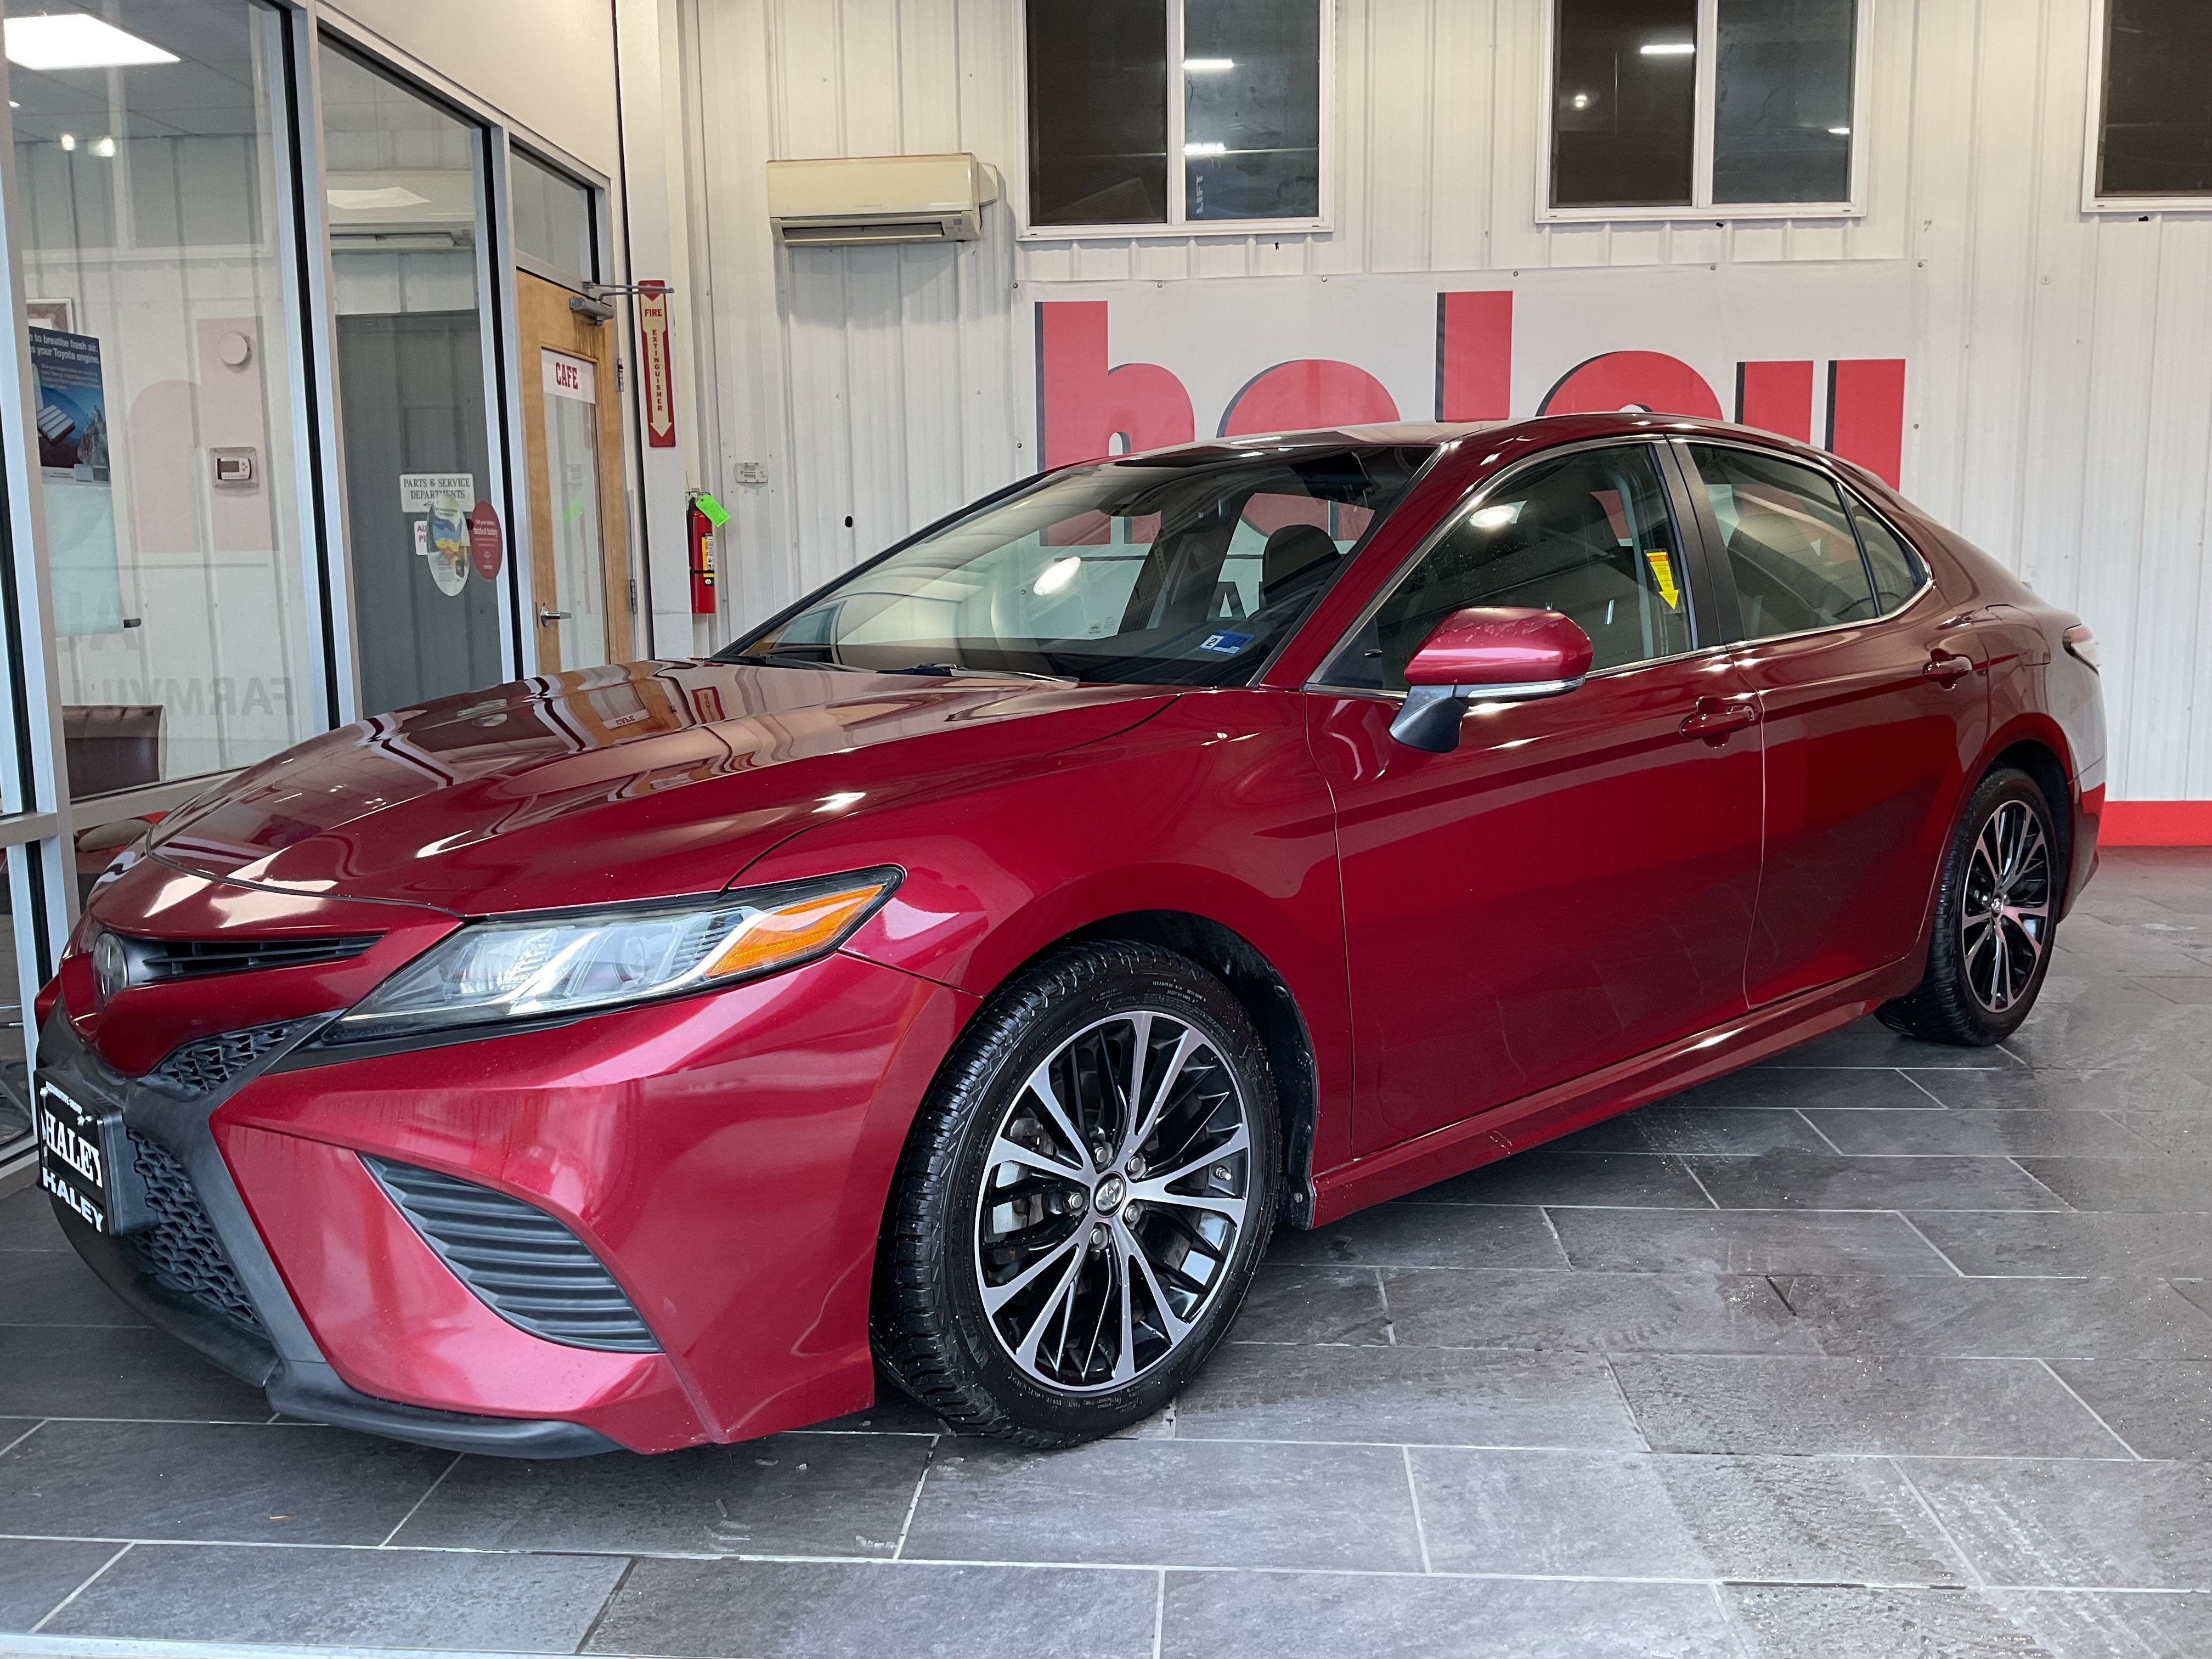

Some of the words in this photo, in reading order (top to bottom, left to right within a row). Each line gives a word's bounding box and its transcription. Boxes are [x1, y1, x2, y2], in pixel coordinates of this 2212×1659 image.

[645, 308, 663, 317] FIRE
[34, 333, 42, 343] to
[43, 334, 69, 348] breathe
[70, 339, 87, 351] fresh
[37, 347, 52, 356] your
[53, 348, 76, 360] Toyota
[555, 362, 578, 390] CAFE
[652, 329, 663, 411] EXTINGUISHER
[403, 478, 427, 488] PARTS
[430, 478, 436, 487] &
[438, 478, 471, 488] SERVICE
[1206, 638, 1218, 647] 2
[44, 1108, 103, 1188] HALEY
[42, 1166, 104, 1233] HALEY
